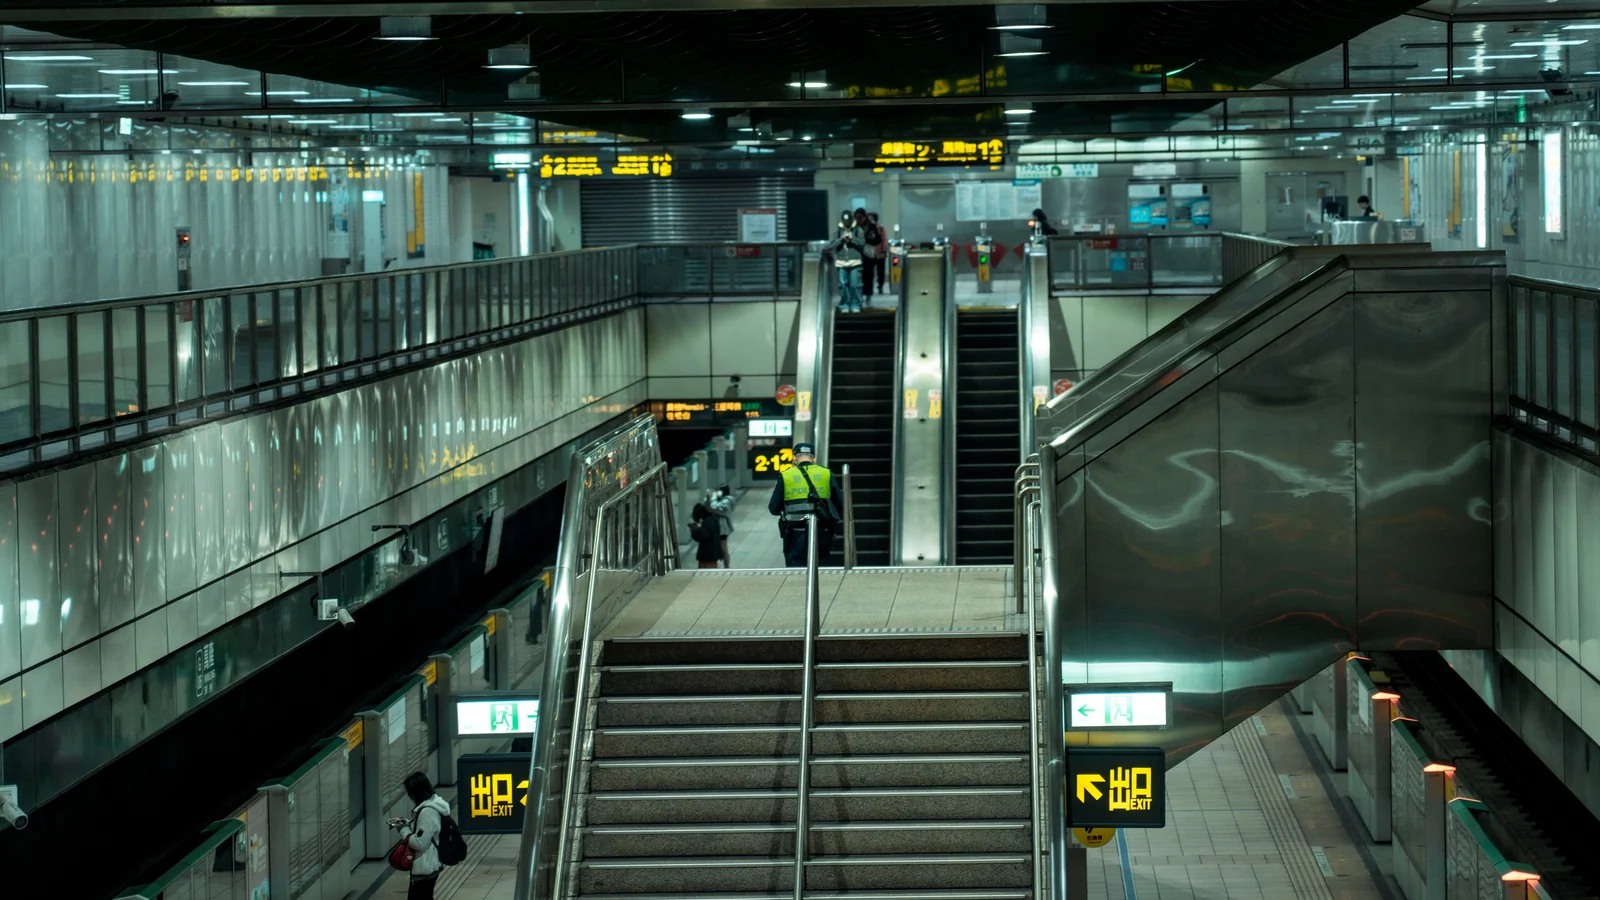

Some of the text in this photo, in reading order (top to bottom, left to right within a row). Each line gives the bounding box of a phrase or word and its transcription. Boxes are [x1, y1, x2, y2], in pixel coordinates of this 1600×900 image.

[470, 773, 513, 818] 出口
[1108, 766, 1152, 811] 出口
[492, 805, 513, 816] EXIT
[1130, 798, 1152, 810] EXIT
